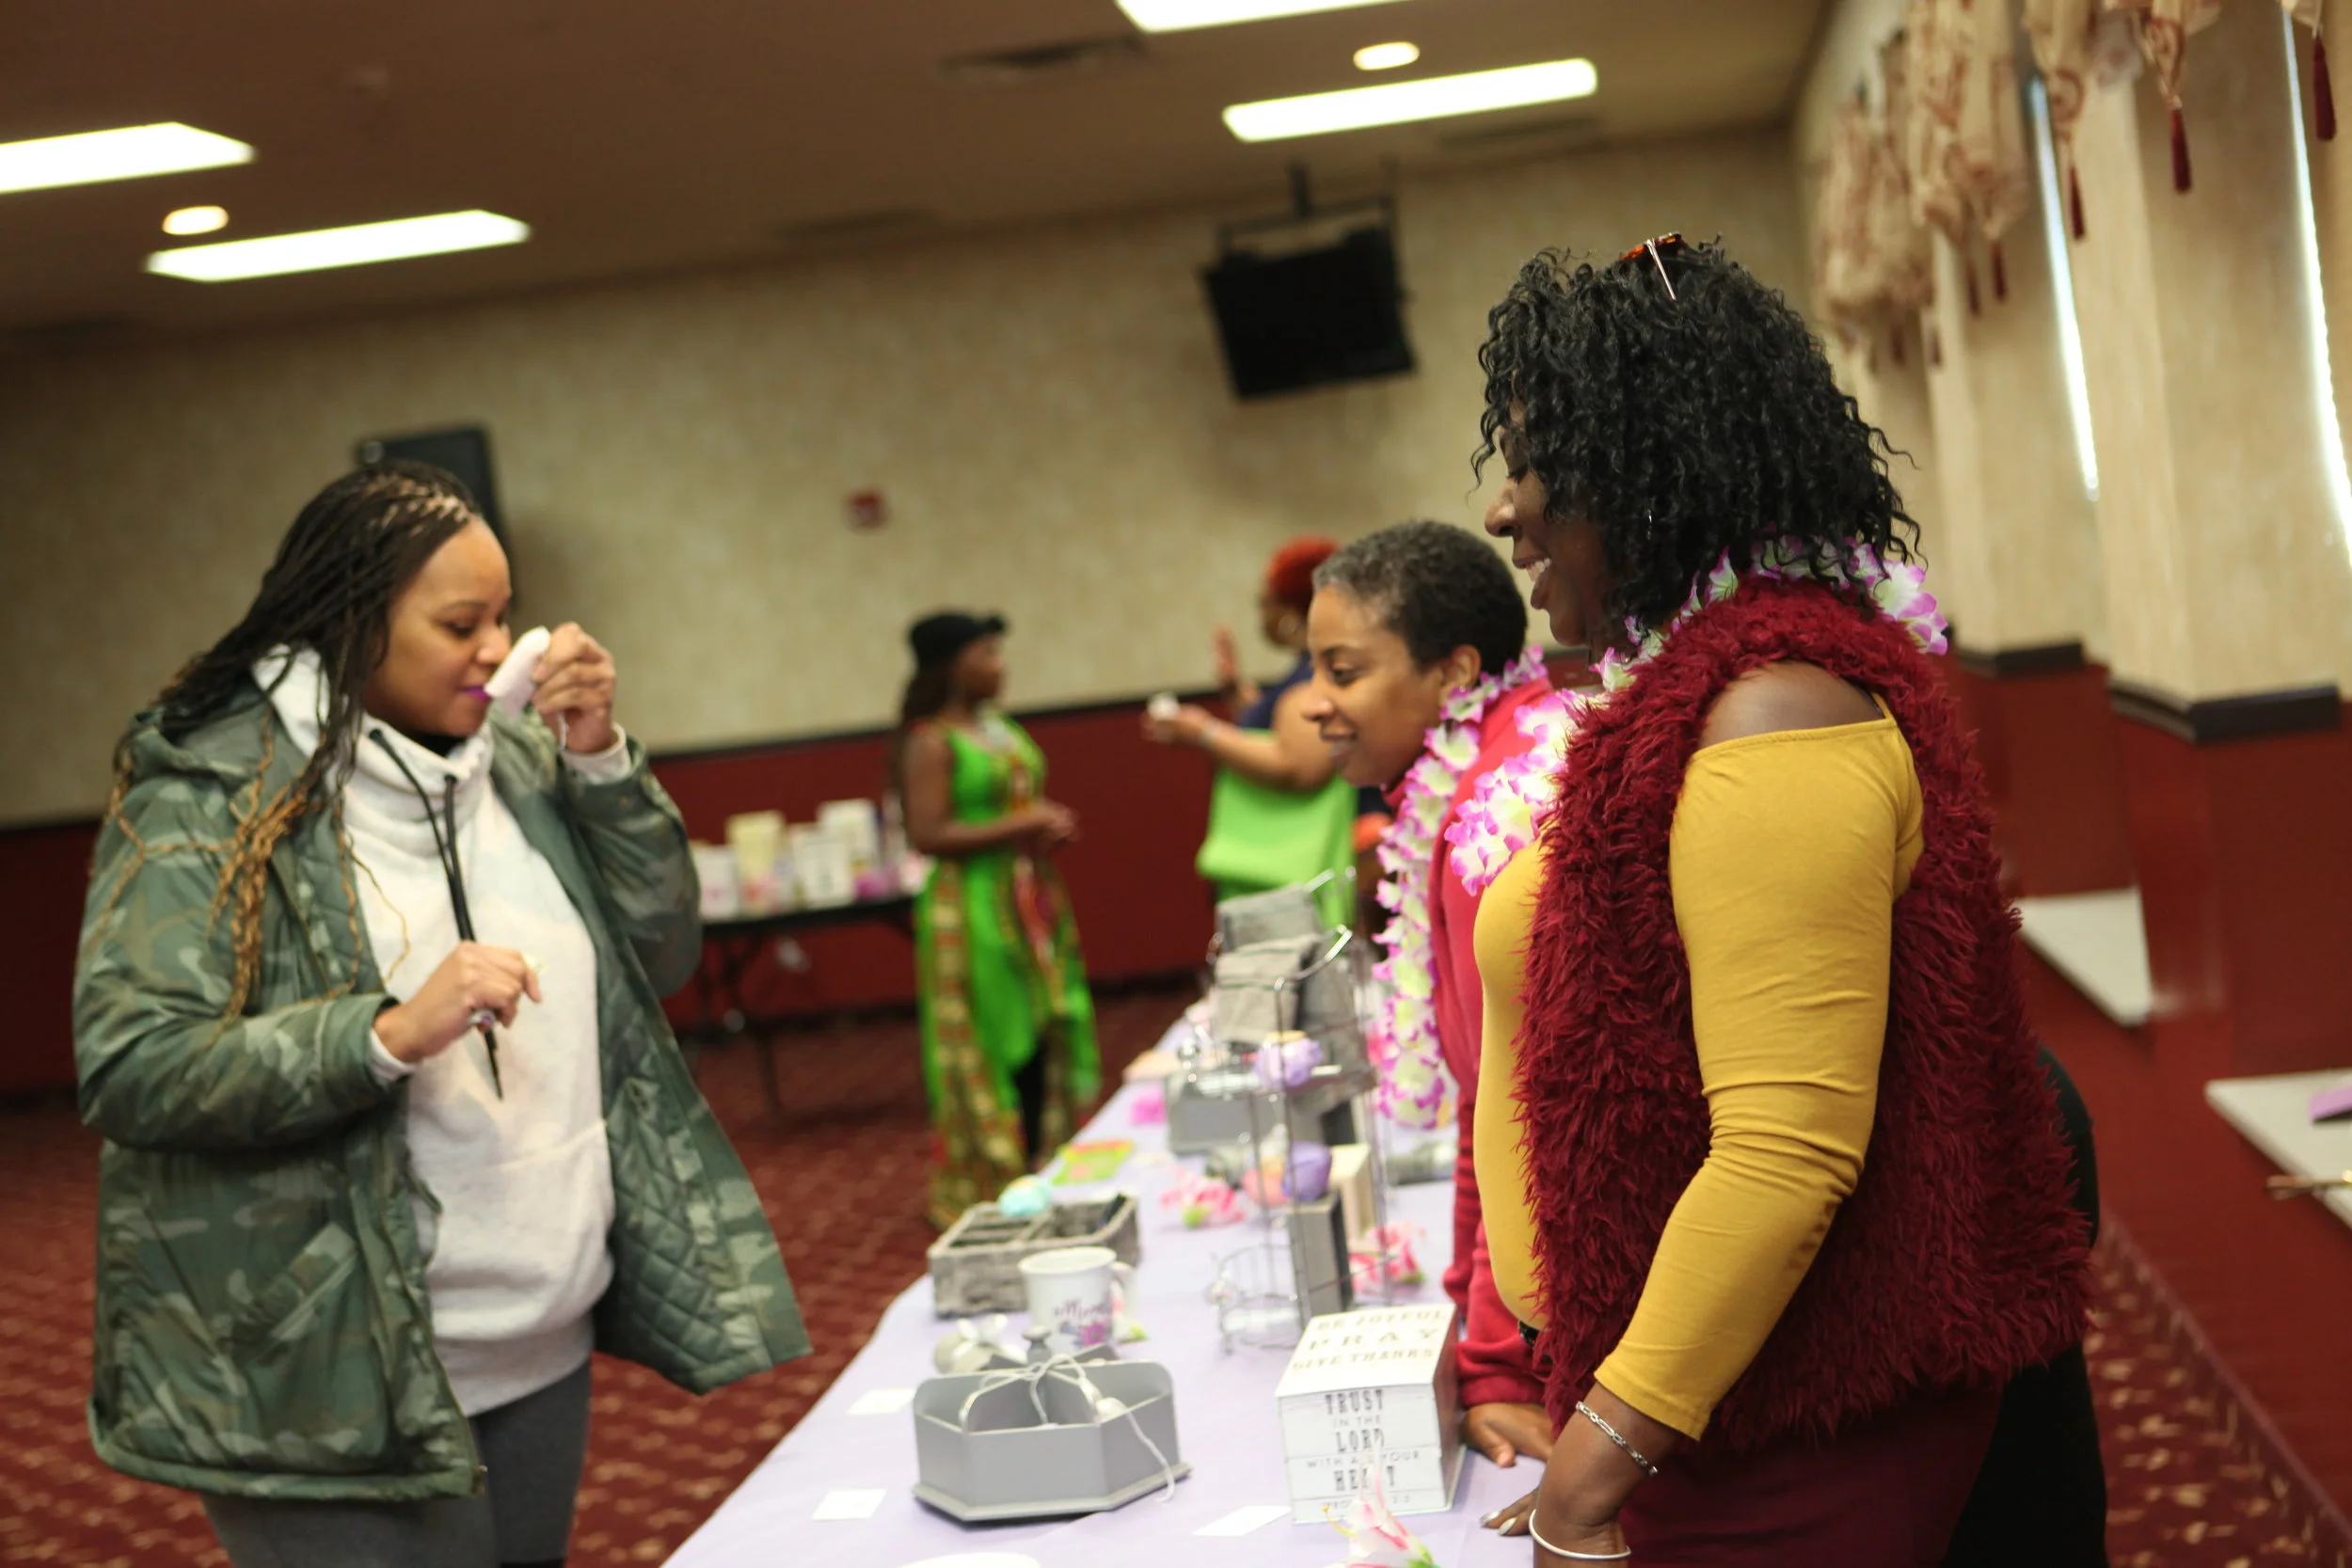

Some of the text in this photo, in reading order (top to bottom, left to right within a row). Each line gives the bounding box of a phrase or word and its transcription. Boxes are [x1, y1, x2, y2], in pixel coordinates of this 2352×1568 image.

[1308, 1328, 1438, 1352] PRAY
[1325, 1388, 1383, 1415] TRUST
[1356, 1415, 1382, 1426] THE
